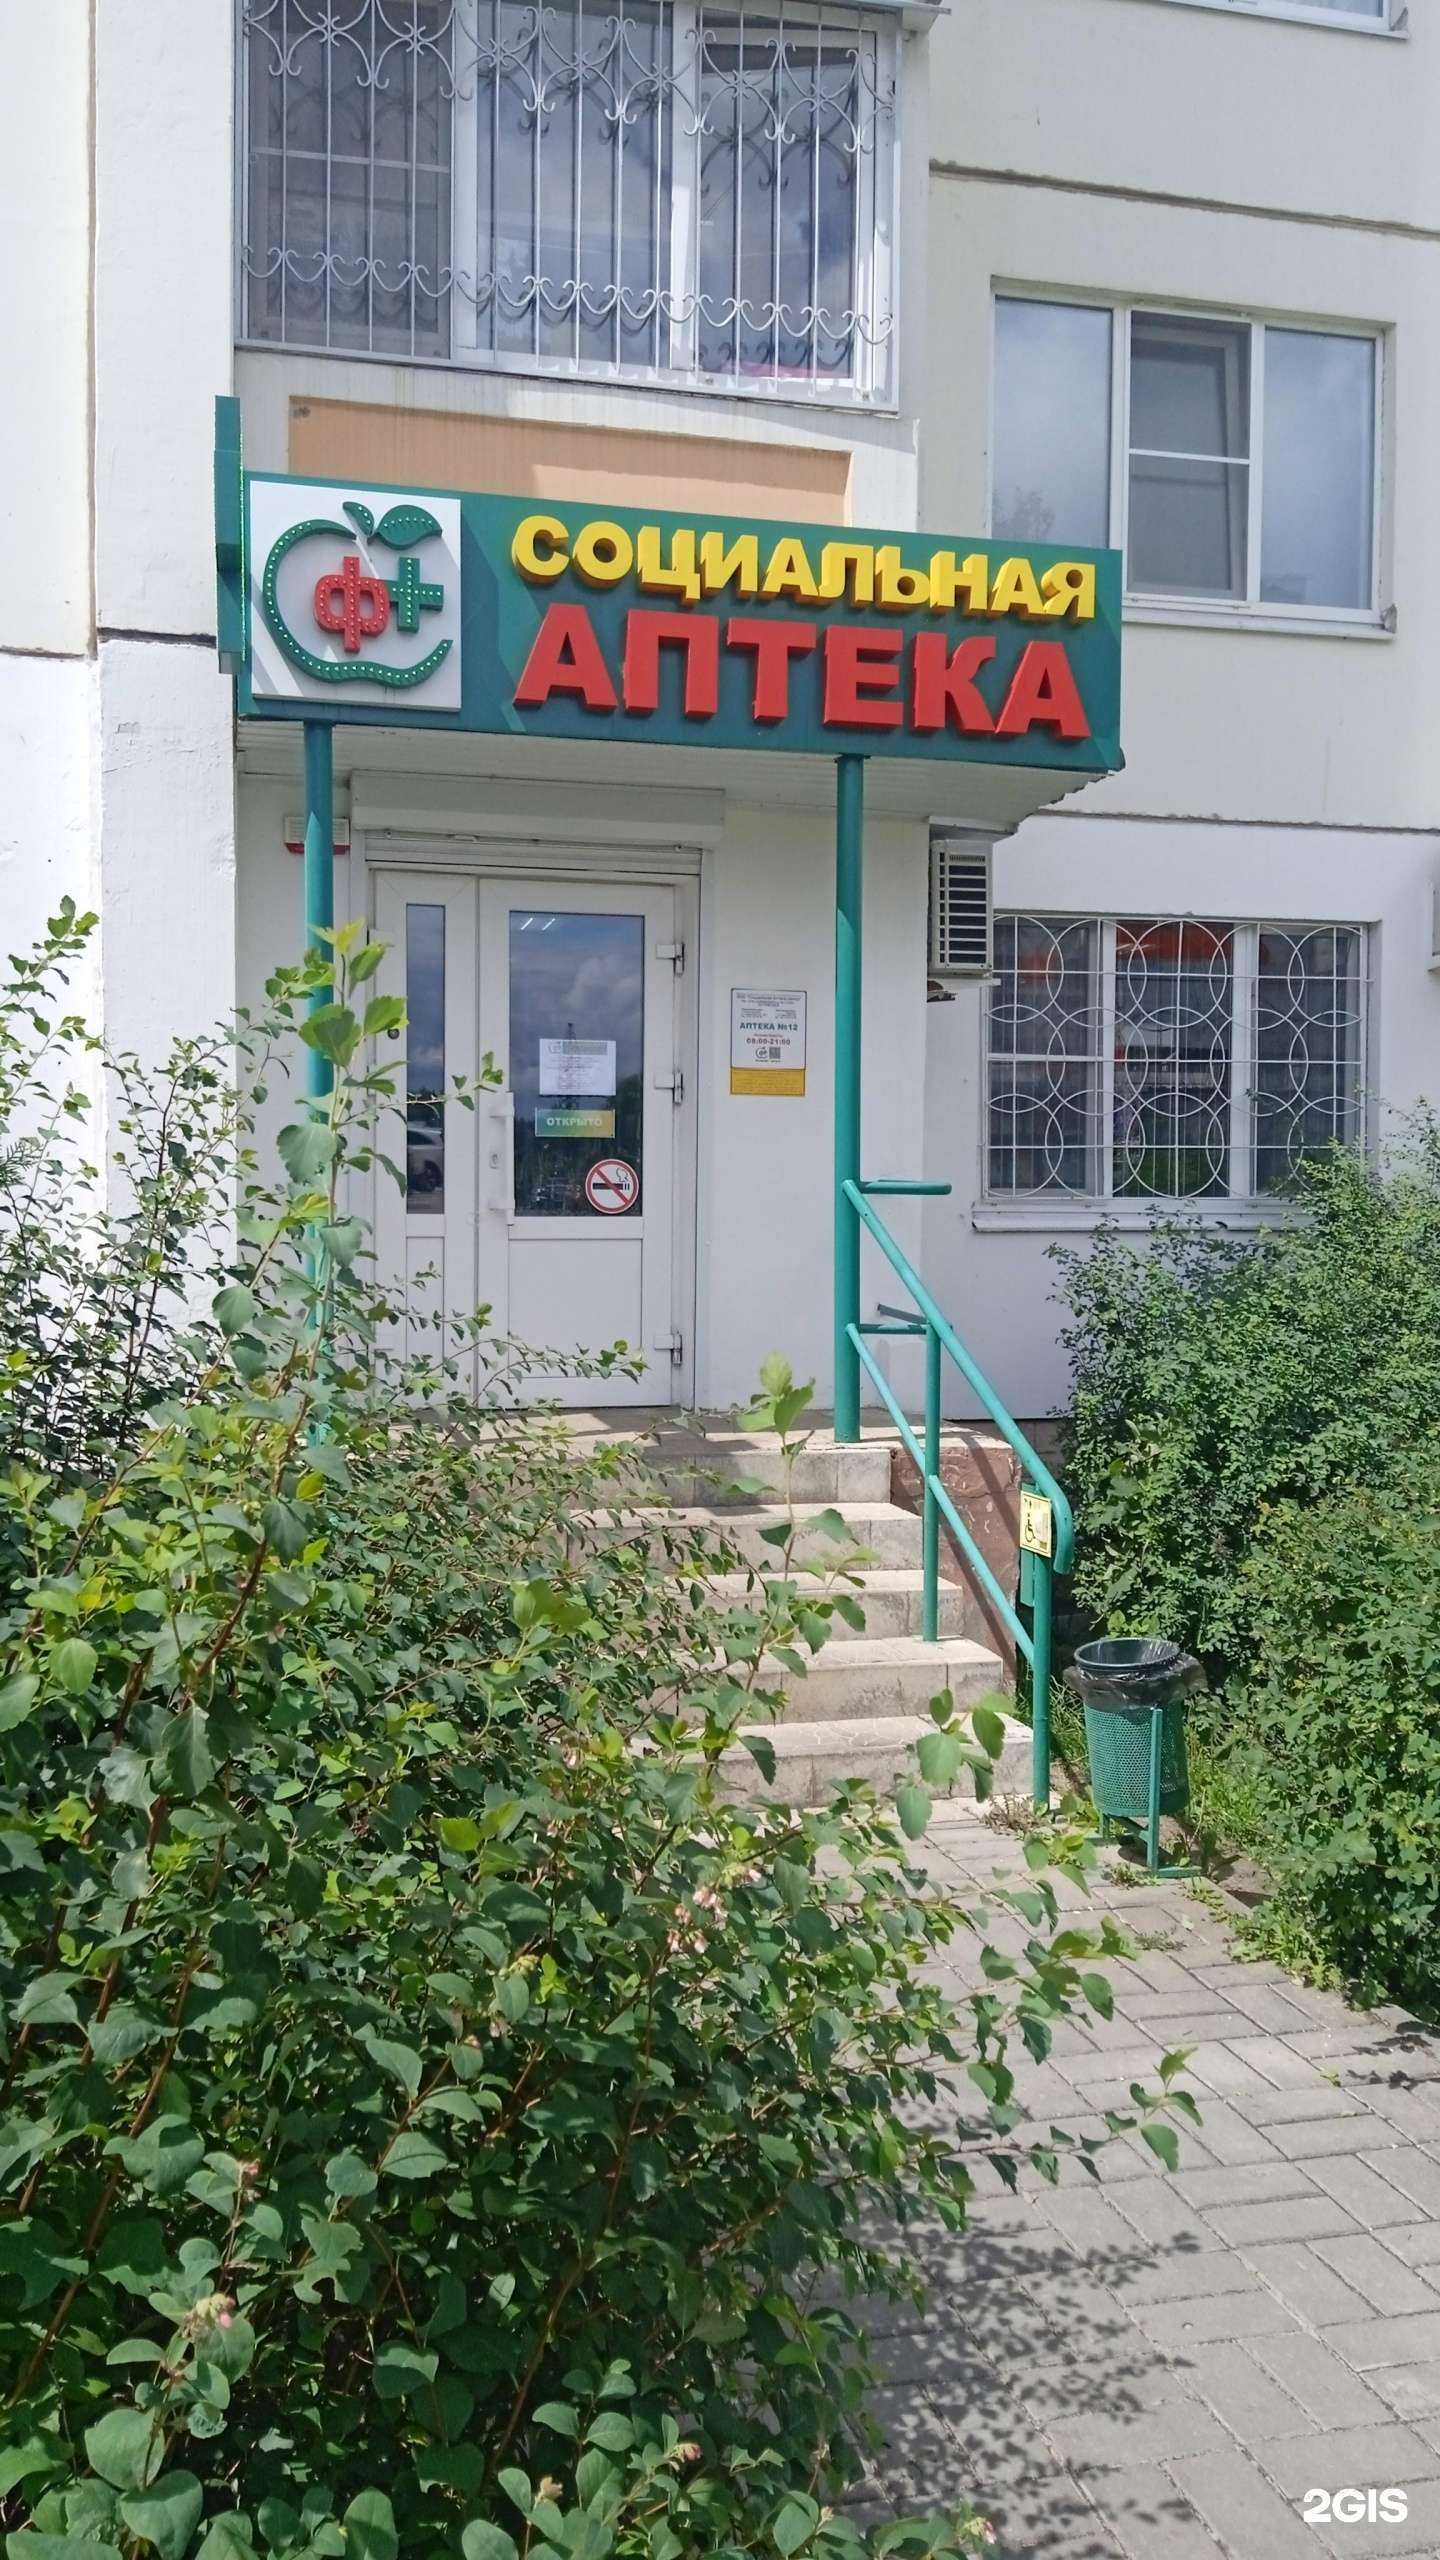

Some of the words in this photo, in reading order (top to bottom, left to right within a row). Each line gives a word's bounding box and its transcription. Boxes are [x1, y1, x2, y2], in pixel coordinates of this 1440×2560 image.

[511, 515, 1096, 622] СОЦИАЛЬНАЯ
[512, 602, 1092, 740] АПТЕКА
[739, 1022, 775, 1031] АПТЕКА
[546, 1117, 603, 1127] ОТКРЫТО
